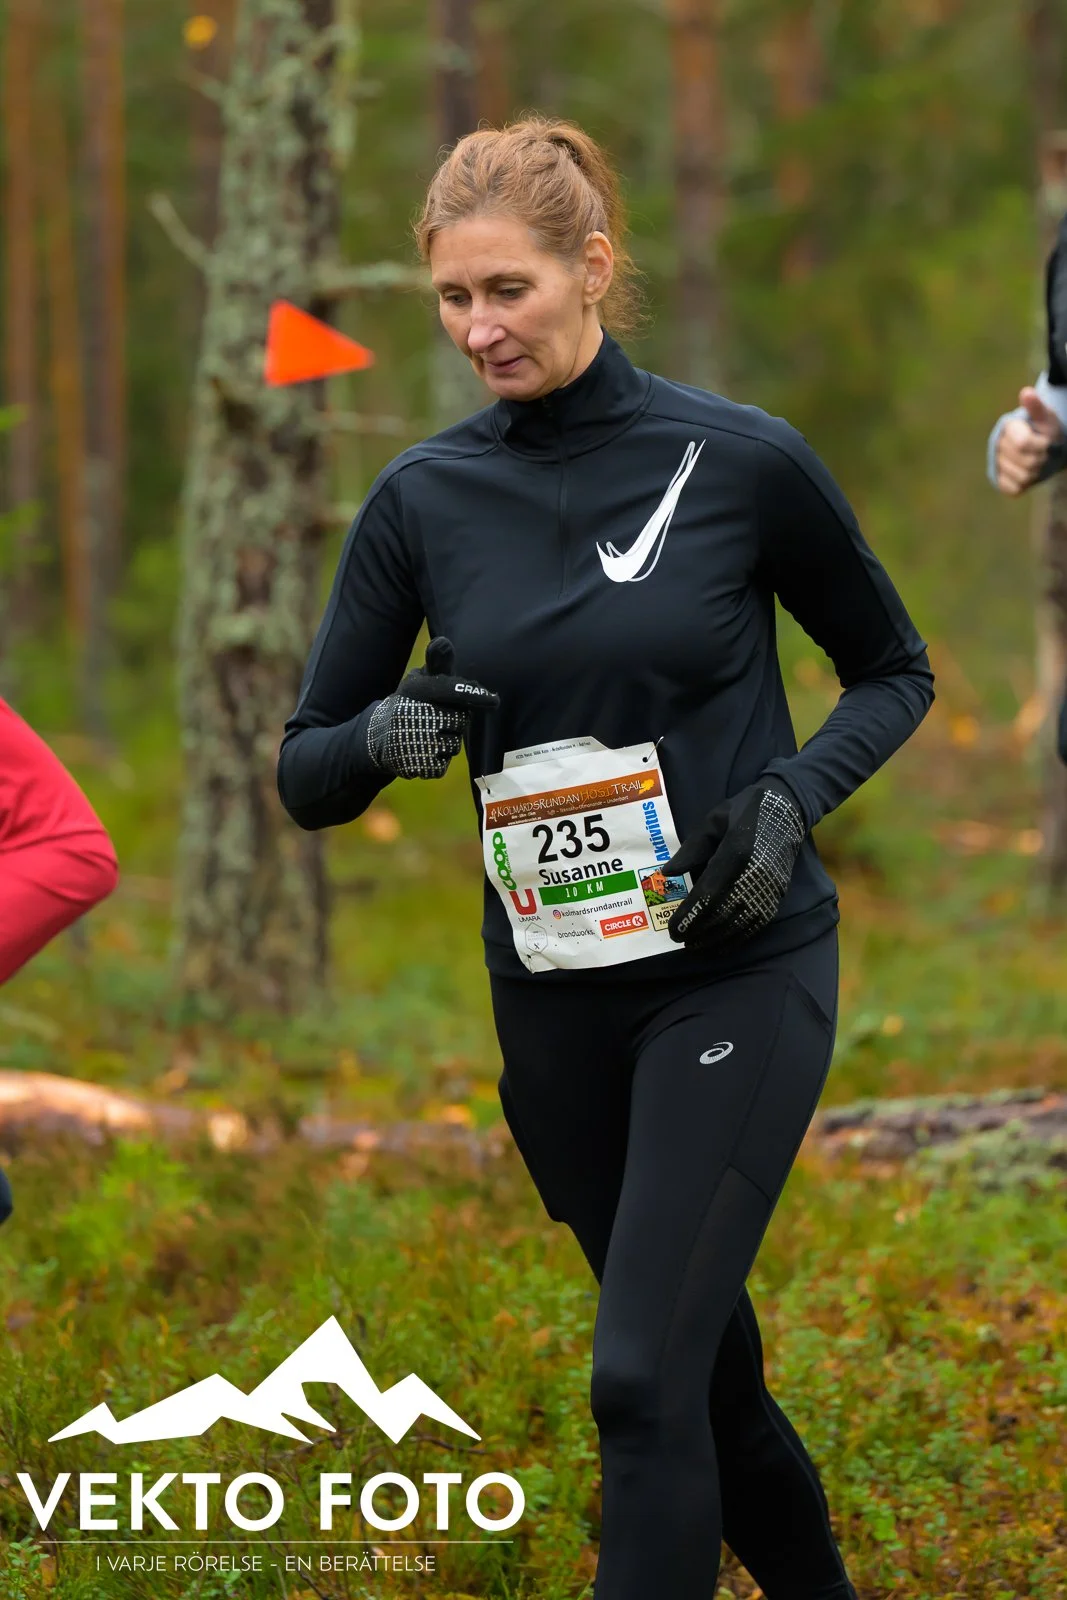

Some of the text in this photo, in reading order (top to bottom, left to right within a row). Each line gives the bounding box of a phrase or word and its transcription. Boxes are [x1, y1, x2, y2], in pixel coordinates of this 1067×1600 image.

[532, 813, 610, 864] 235
[642, 801, 672, 861] Aktivitus
[538, 858, 623, 886] Susanne
[565, 881, 604, 898] 10 KM
[561, 898, 633, 917] kolmardsrundantrail
[655, 908, 677, 920] NØT
[677, 901, 703, 933] CRAFT
[518, 915, 541, 923] UMARA
[604, 919, 632, 931] CIRCLE
